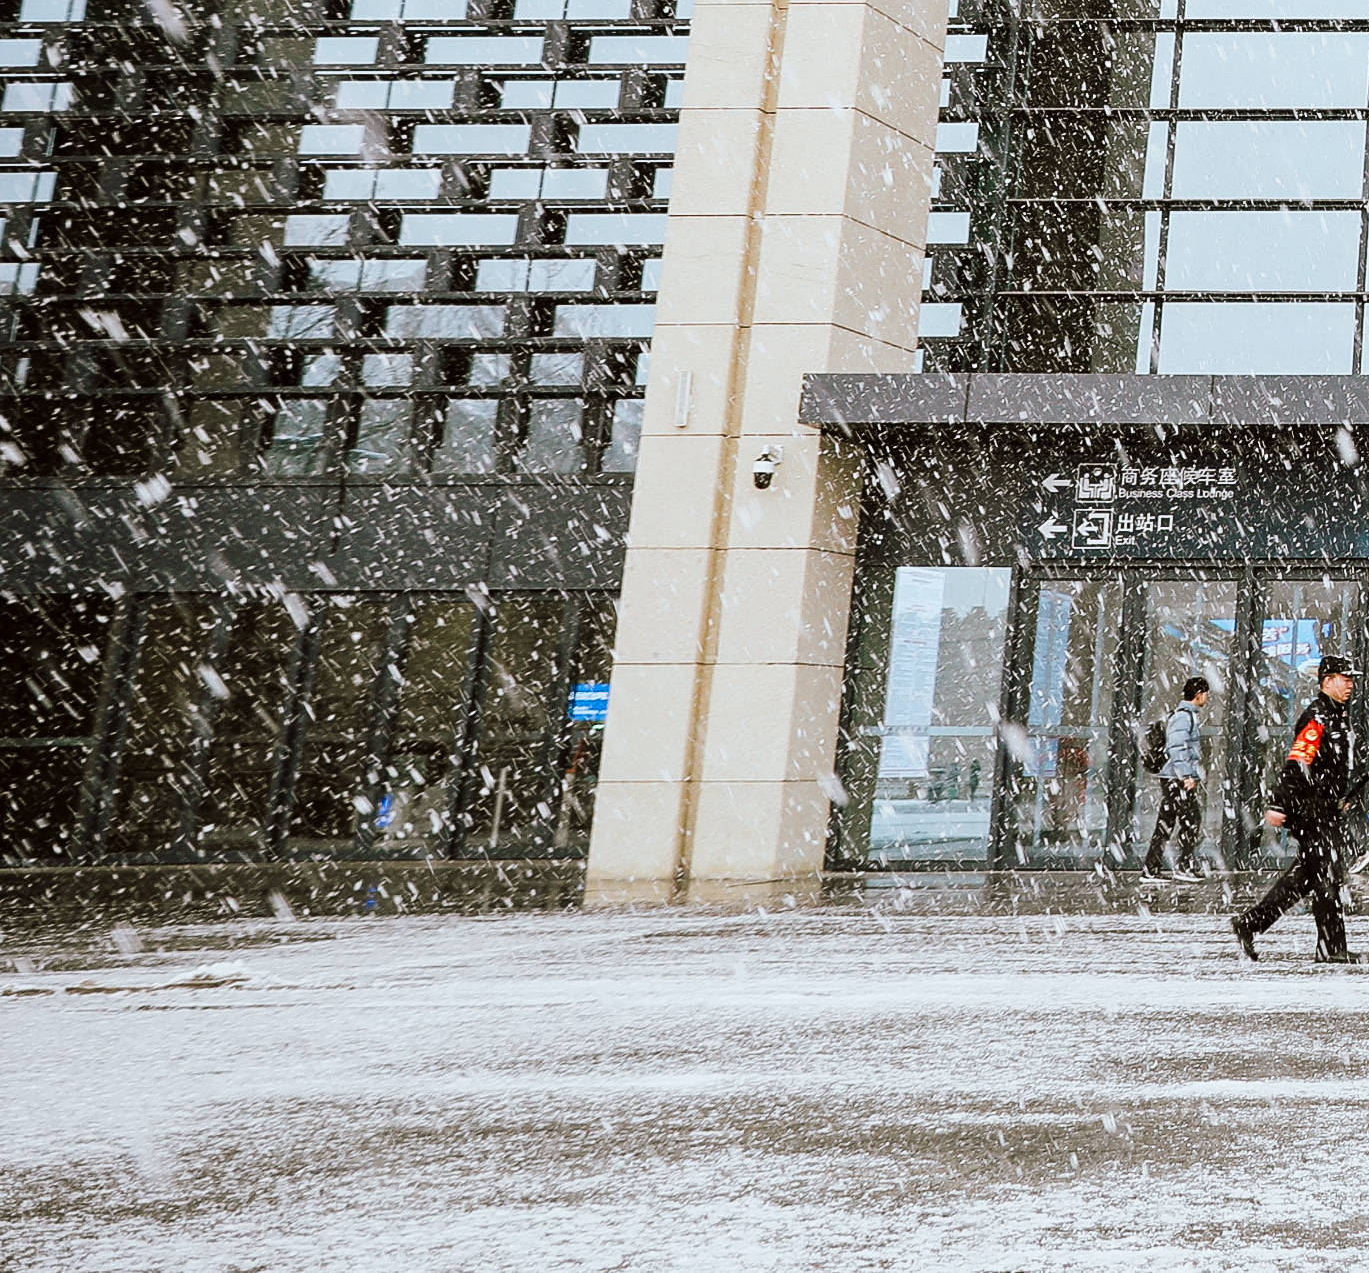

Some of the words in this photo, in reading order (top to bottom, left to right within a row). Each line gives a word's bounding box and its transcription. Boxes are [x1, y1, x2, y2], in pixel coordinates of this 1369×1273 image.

[1120, 466, 1238, 487] 商务座候车室
[1119, 488, 1163, 499] Business
[1166, 488, 1194, 499] Class
[1196, 488, 1234, 501] Lounge
[1115, 513, 1174, 534] 出站口
[1115, 535, 1135, 546] Exit
